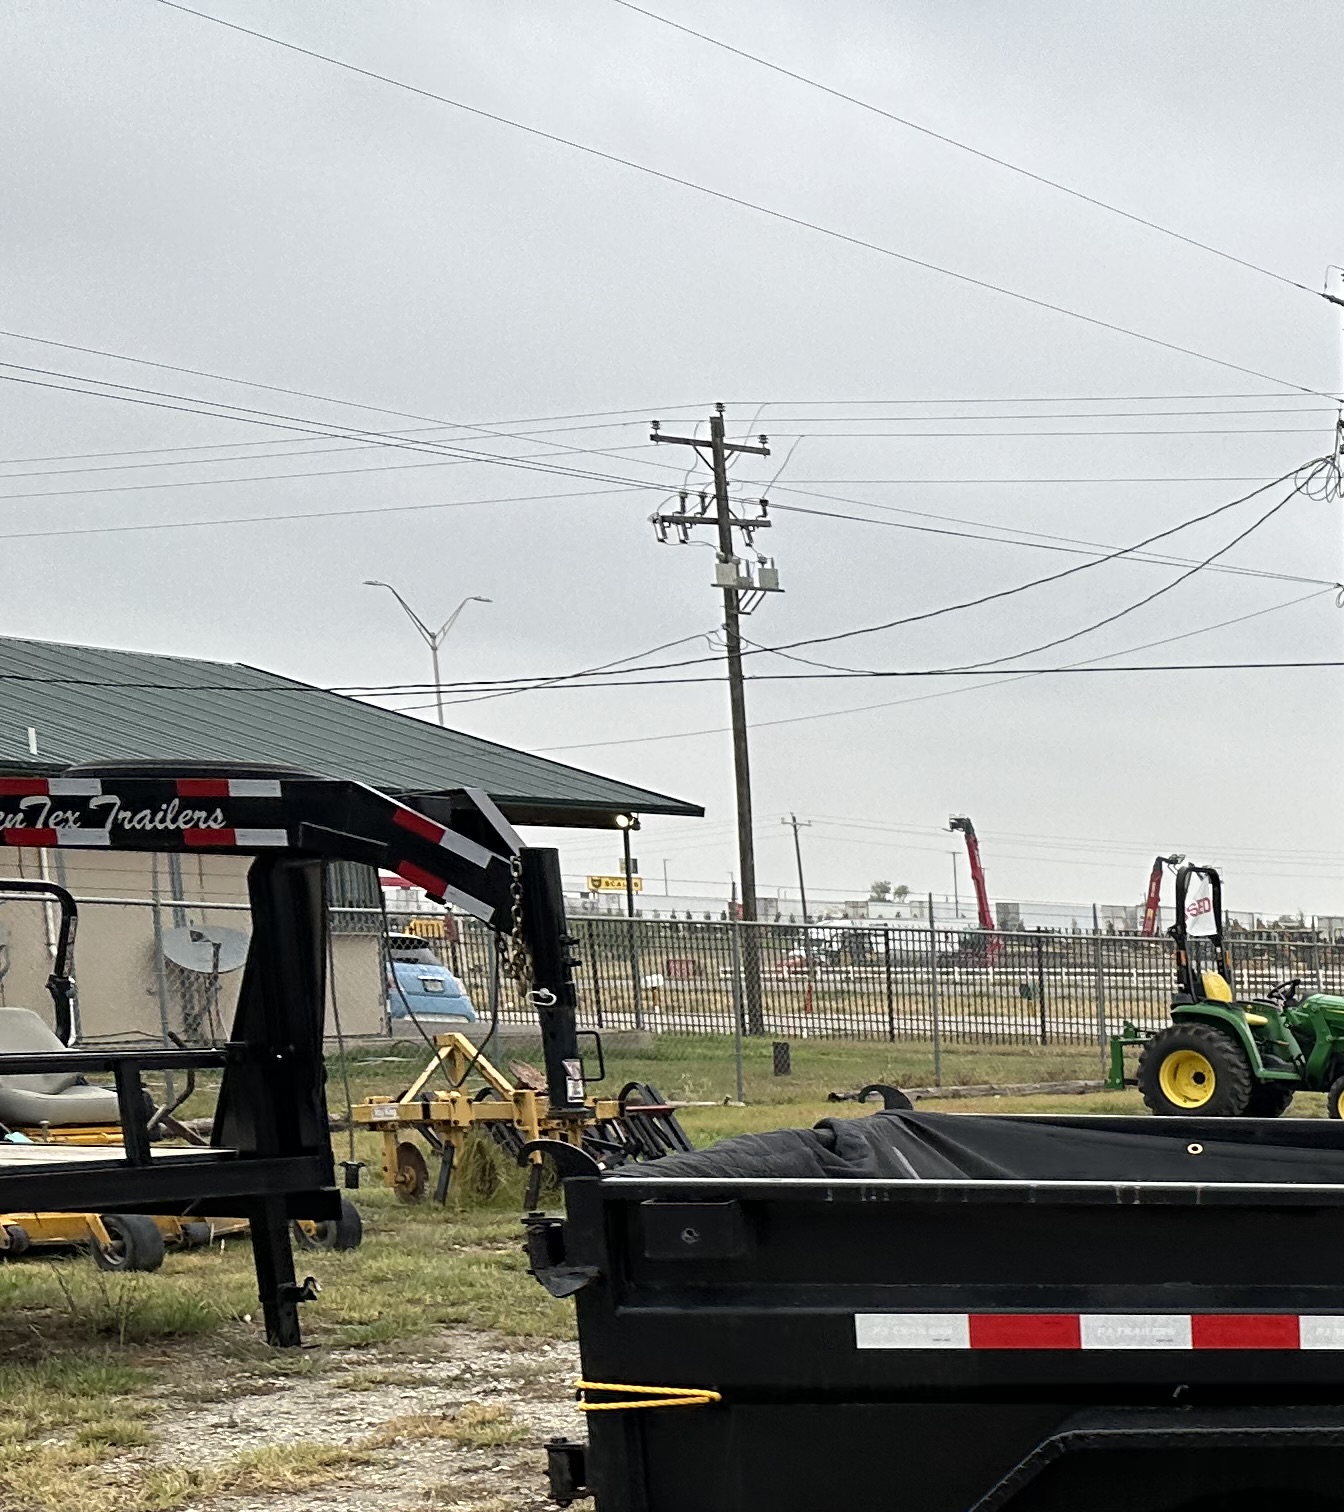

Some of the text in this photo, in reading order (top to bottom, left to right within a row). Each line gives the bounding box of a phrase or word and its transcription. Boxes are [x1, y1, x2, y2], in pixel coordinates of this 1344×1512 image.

[89, 795, 227, 831] Trailers
[604, 880, 639, 888] SCALS
[1185, 897, 1211, 921] SED
